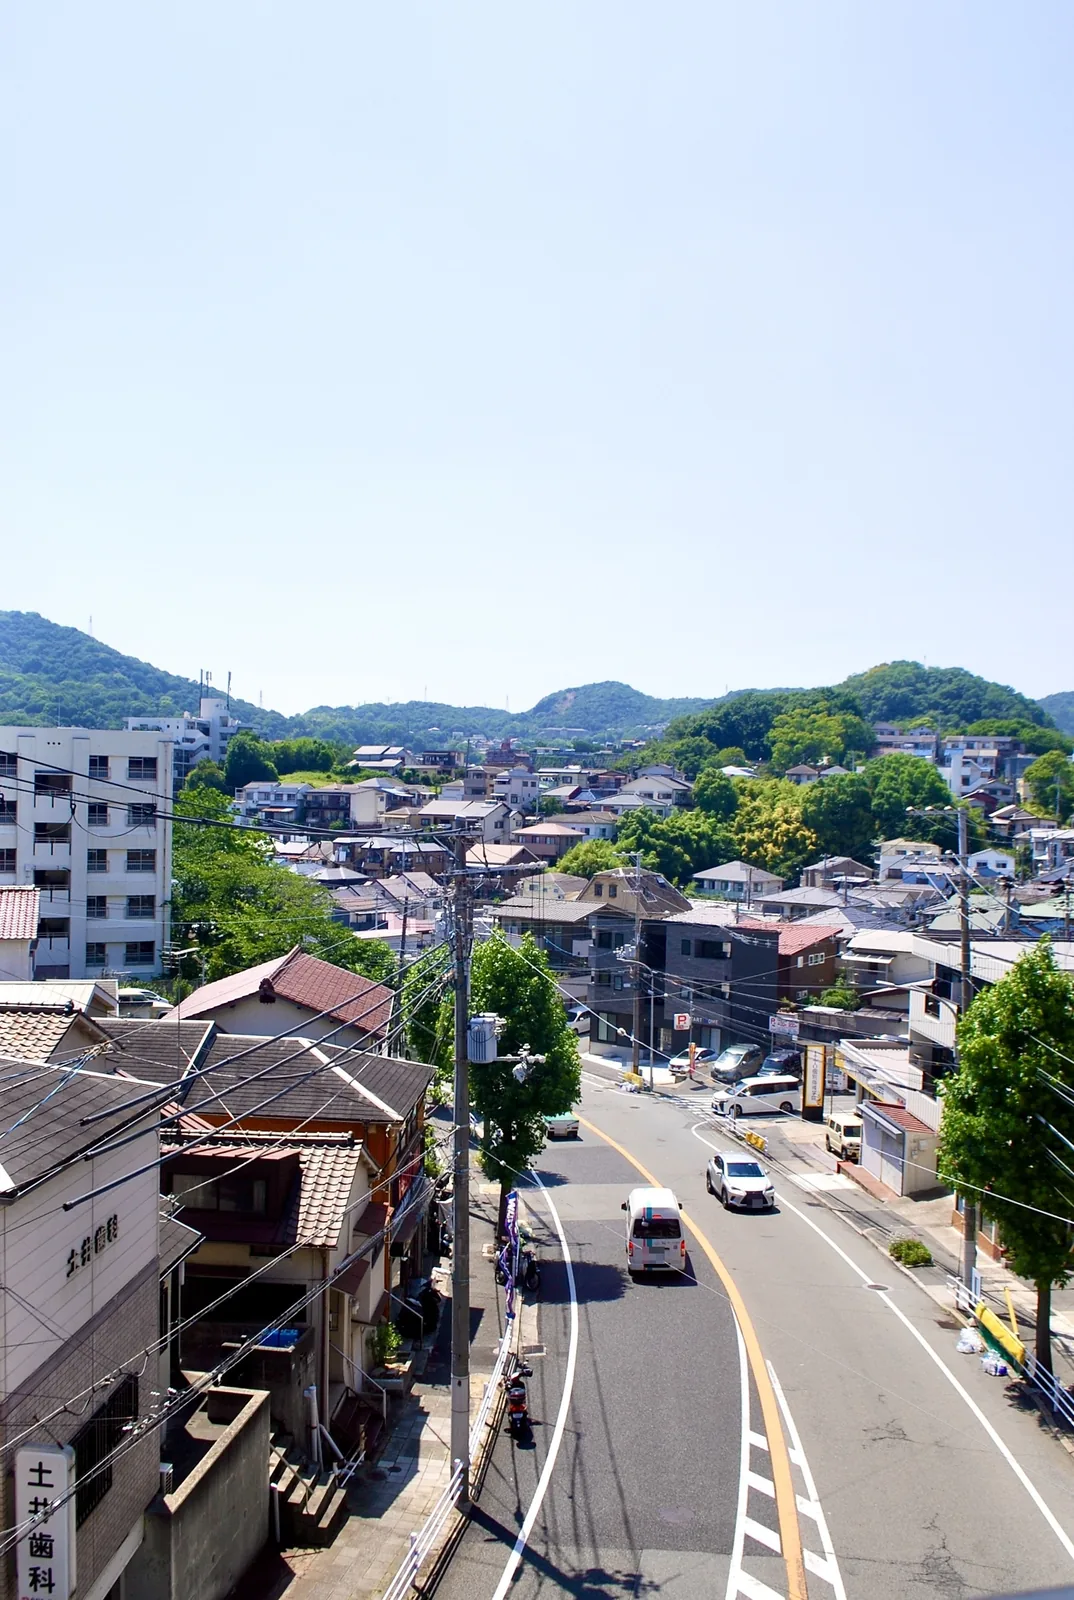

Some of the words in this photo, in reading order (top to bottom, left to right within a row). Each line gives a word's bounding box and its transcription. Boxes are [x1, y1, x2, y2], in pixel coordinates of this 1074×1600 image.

[678, 1015, 687, 1025] P
[67, 1214, 118, 1278] 土井歯科
[27, 1461, 55, 1594] 土井歯科
